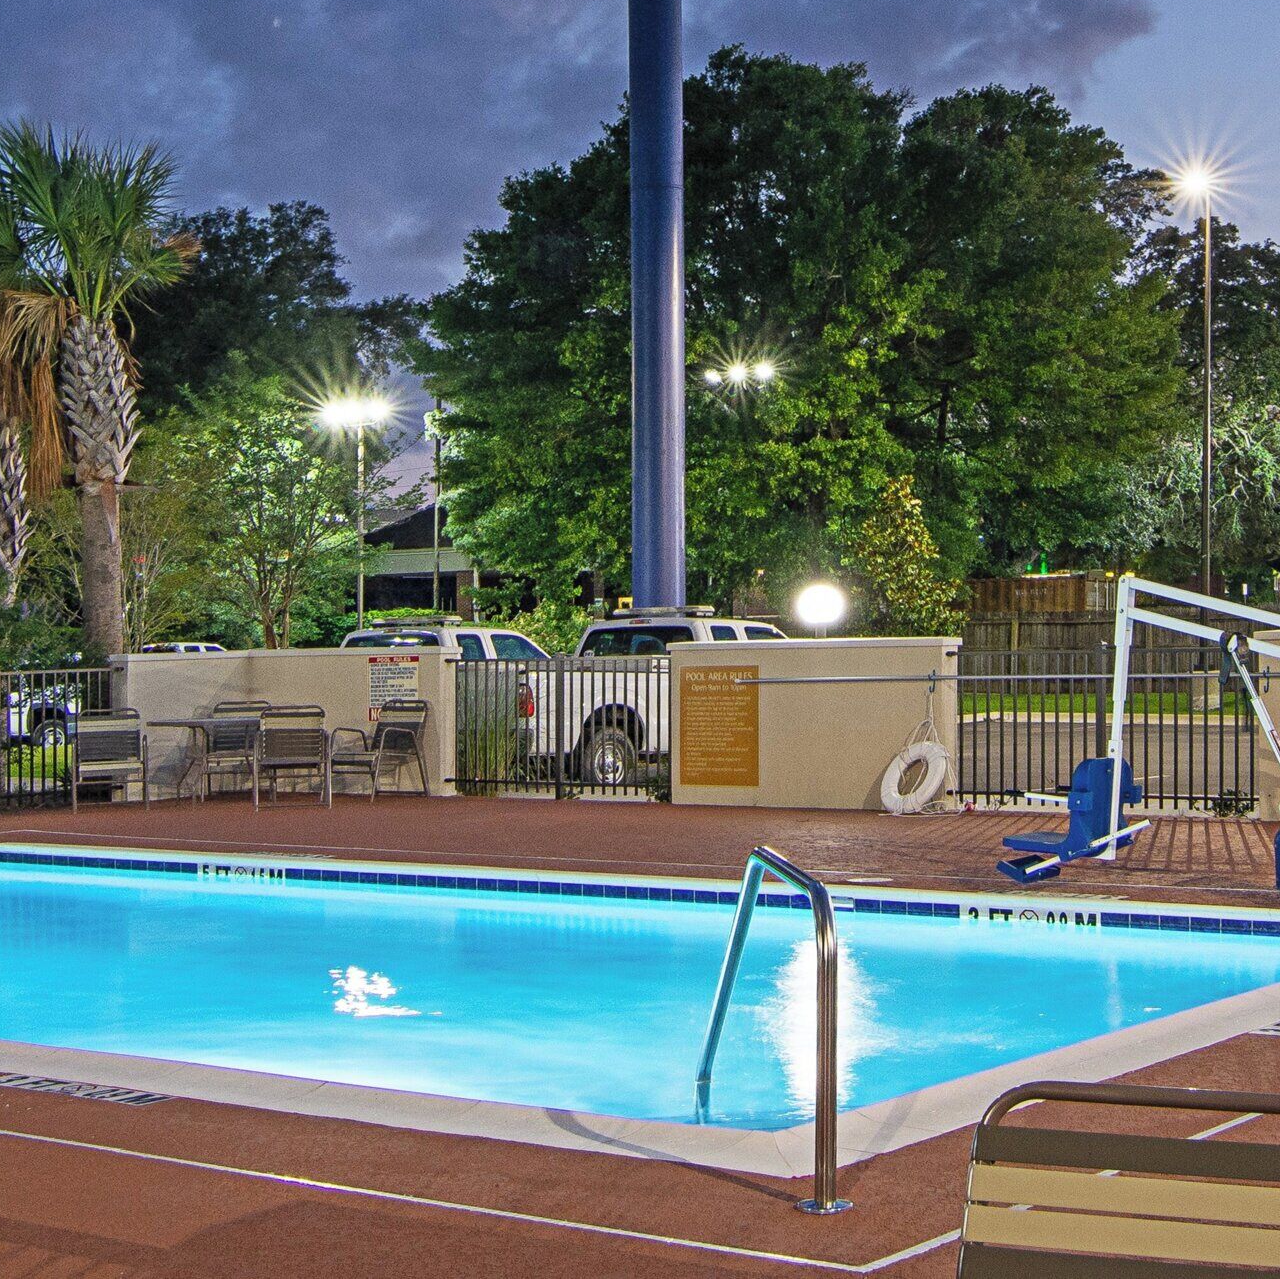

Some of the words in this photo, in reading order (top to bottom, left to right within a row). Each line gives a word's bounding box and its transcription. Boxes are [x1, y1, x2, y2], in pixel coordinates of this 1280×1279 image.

[685, 671, 705, 681] POOL
[708, 671, 728, 681] AREA
[729, 671, 753, 681] RULES
